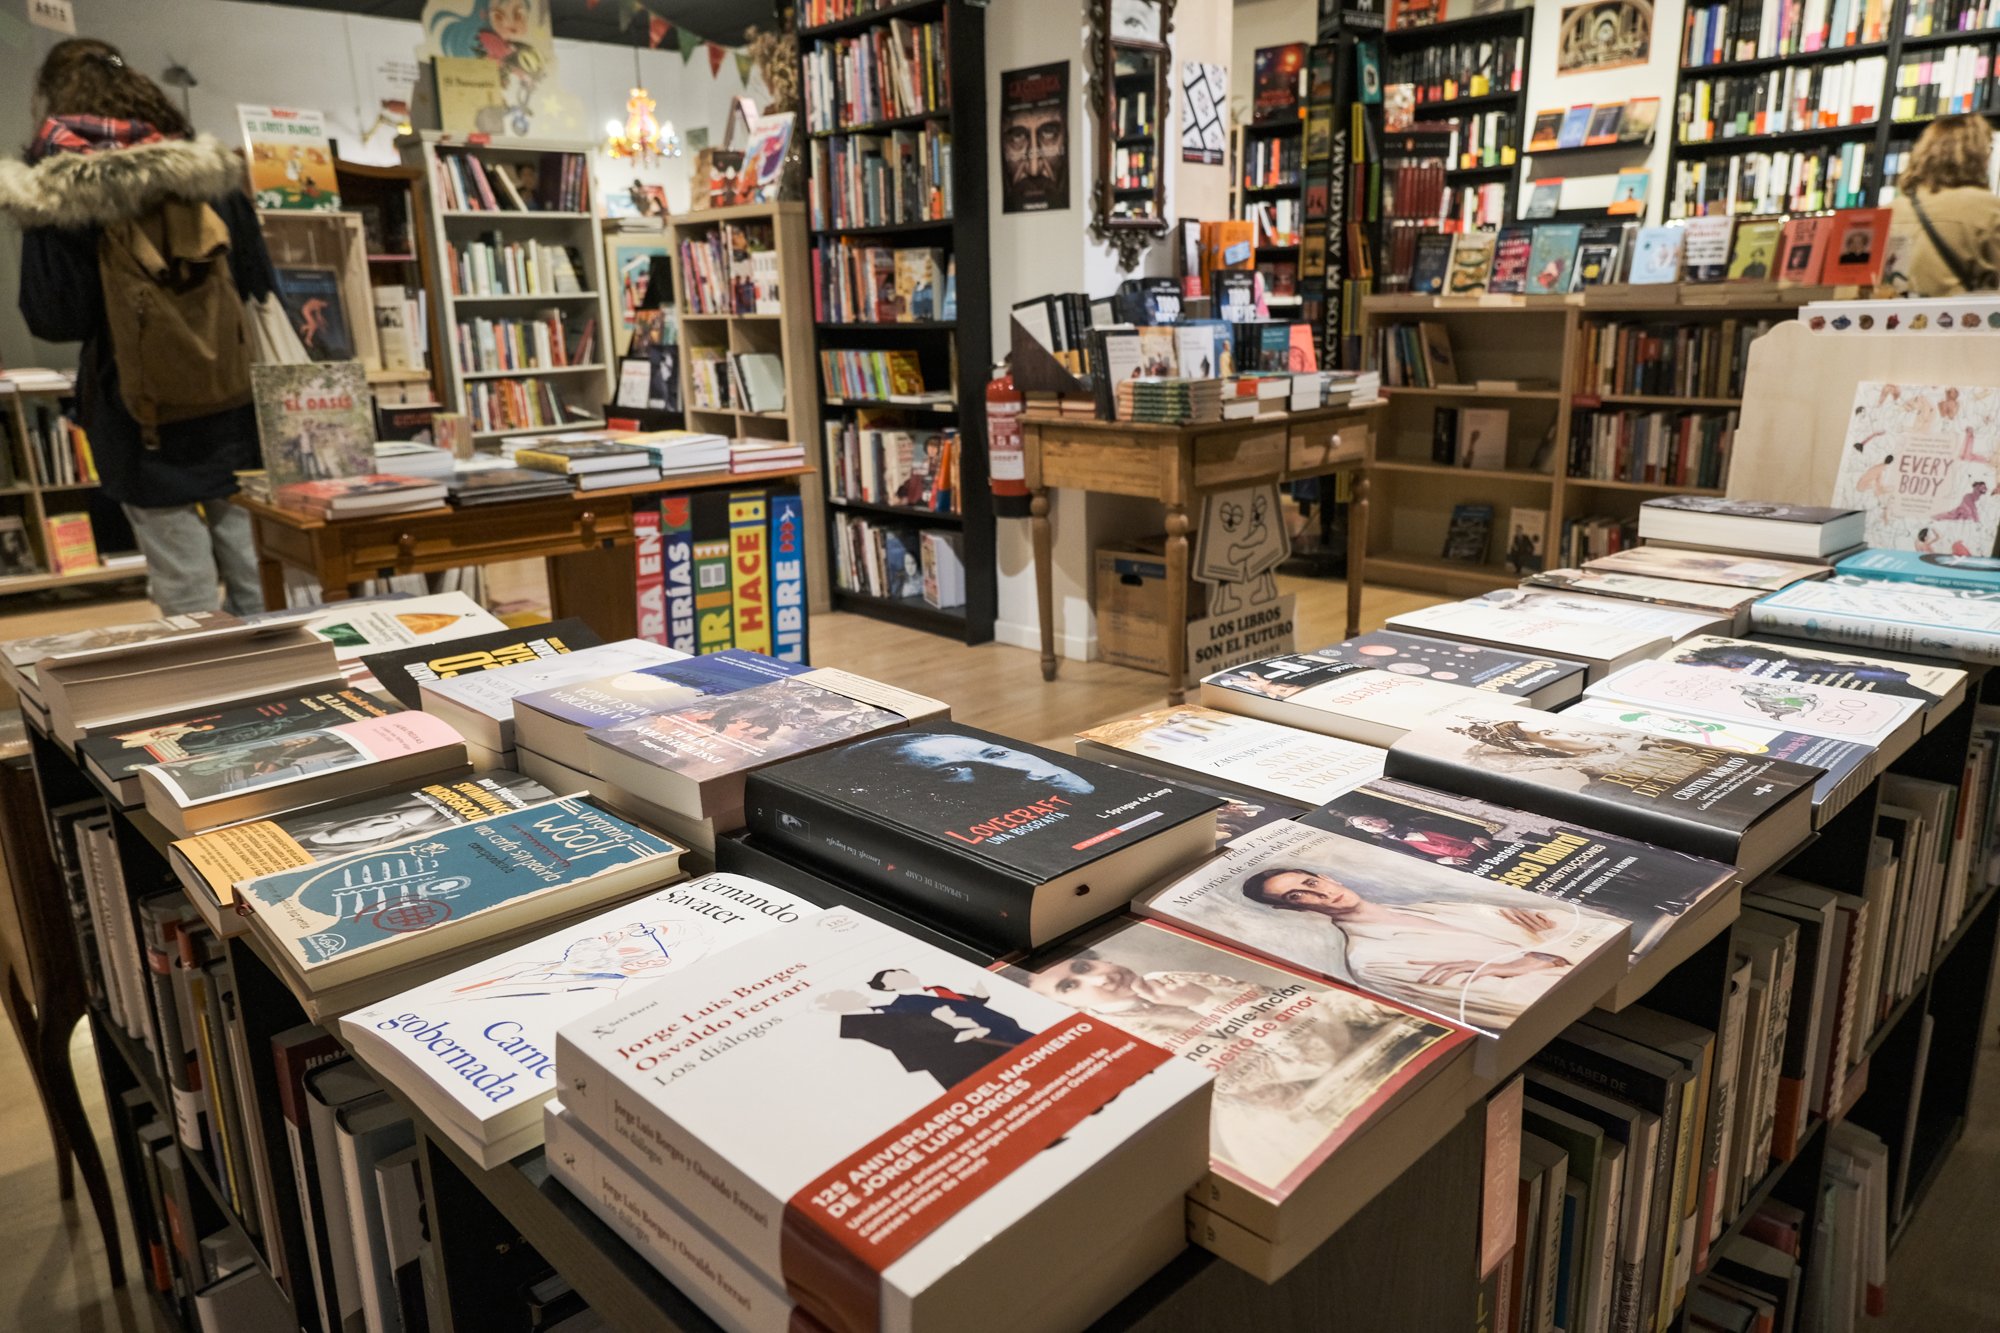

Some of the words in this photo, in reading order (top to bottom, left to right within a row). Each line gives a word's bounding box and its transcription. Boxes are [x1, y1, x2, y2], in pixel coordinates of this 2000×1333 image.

[1329, 128, 1346, 257] ANAGRAMA
[1899, 455, 1954, 477] EVERY
[1899, 474, 1944, 497] BODY
[737, 532, 764, 633] HACE
[776, 559, 802, 664] LIBRE
[1209, 619, 1234, 641] LOS
[1237, 606, 1281, 635] LIBROS
[1195, 644, 1223, 664] SON
[1226, 639, 1243, 657] EL
[1244, 620, 1293, 648] FUTURO
[550, 690, 617, 717] HISTORIA
[670, 728, 723, 750] ANIMAL
[452, 782, 514, 816] SWIMMING
[1106, 798, 1140, 816] Sprague
[1148, 787, 1174, 800] Camp
[1672, 773, 1716, 801] CRISTINA
[944, 794, 1073, 845] LOVECRAFT
[985, 832, 1015, 846] UNA
[1013, 811, 1071, 837] BIOGRAFÍA
[1173, 872, 1233, 907] Memorias
[1230, 862, 1248, 876] de
[1247, 850, 1273, 868] antes
[1271, 840, 1287, 853] del
[1487, 842, 1526, 867] Besteiro
[1519, 830, 1591, 866] Umbral
[1534, 880, 1551, 894] DE
[1549, 843, 1607, 884] INSTRUCCIONES
[656, 888, 747, 926] Savater
[697, 876, 800, 925] Fernando
[1570, 935, 1593, 950] ALBA
[616, 1022, 682, 1061] Jorge
[682, 997, 733, 1024] Luis
[731, 960, 808, 1000] Borges
[635, 1017, 733, 1073] Osvaldo
[733, 979, 813, 1020] Ferrari
[1208, 982, 1307, 1041] Valle-Inclán
[1252, 1020, 1278, 1039] de
[1273, 995, 1319, 1023] amor
[377, 1010, 517, 1104] gobernada
[483, 1020, 558, 1080] Carne
[652, 1060, 697, 1088] Los
[699, 1014, 783, 1063] diálogos
[1569, 1057, 1609, 1084] SABER
[812, 1180, 850, 1209] 125
[847, 1101, 969, 1187] ANIVERSARIO
[964, 1077, 1004, 1107] DEL
[997, 1022, 1094, 1084] NACIMIENTO
[967, 1126, 1011, 1161] Borges
[1066, 1057, 1108, 1090] Osvaldo
[1104, 1040, 1139, 1068] Ferrari
[827, 1194, 861, 1220] DE
[860, 1149, 926, 1197] JORGE
[924, 1119, 966, 1154] LUIS
[960, 1078, 1032, 1128] BORGES
[911, 1151, 959, 1188] primera
[1026, 1074, 1068, 1109] volumen
[614, 1098, 636, 1126] Jorge
[636, 1116, 655, 1138] Luis
[655, 1126, 685, 1163] Borges
[692, 1161, 732, 1200] Osvaldo
[732, 1190, 769, 1229] Ferrari
[602, 1176, 623, 1203] Jorge
[642, 1208, 671, 1243] Borges
[678, 1241, 717, 1284] Osvaldo
